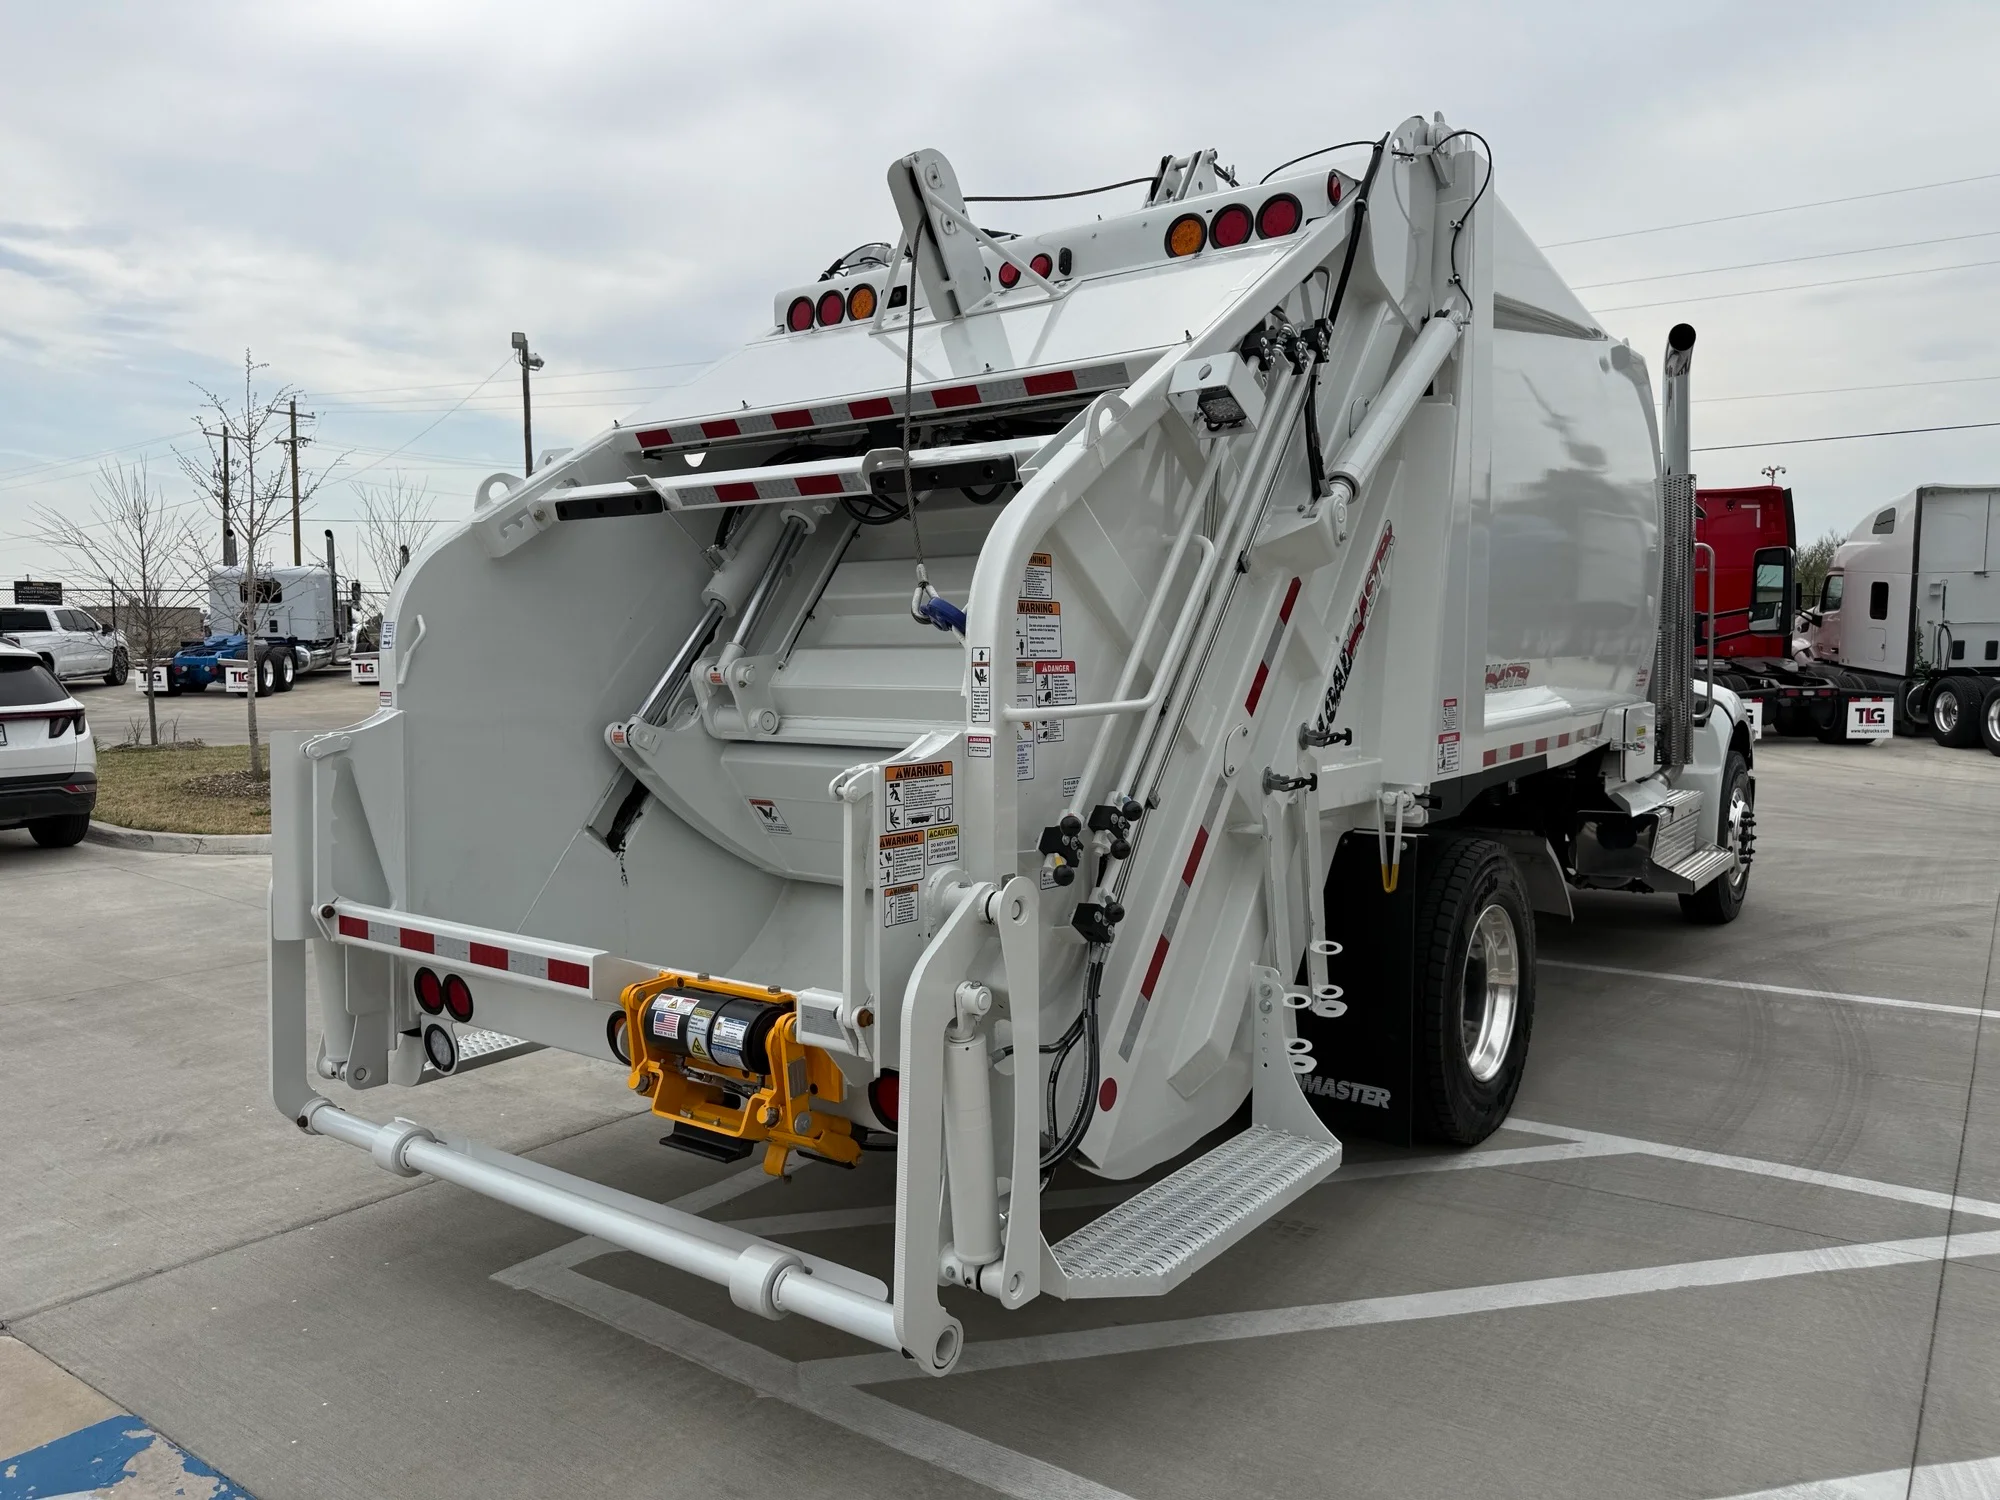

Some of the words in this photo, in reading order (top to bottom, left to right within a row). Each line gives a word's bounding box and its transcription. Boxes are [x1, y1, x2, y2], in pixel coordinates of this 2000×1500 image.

[1029, 556, 1047, 564] NING
[1019, 602, 1053, 613] WARNING
[355, 664, 374, 673] TLG
[1048, 664, 1070, 672] DANGER
[140, 671, 162, 681] TG
[1855, 708, 1885, 724] TLG
[903, 764, 944, 778] WARNING
[934, 828, 957, 837] CAUTION
[885, 834, 918, 846] WARNING
